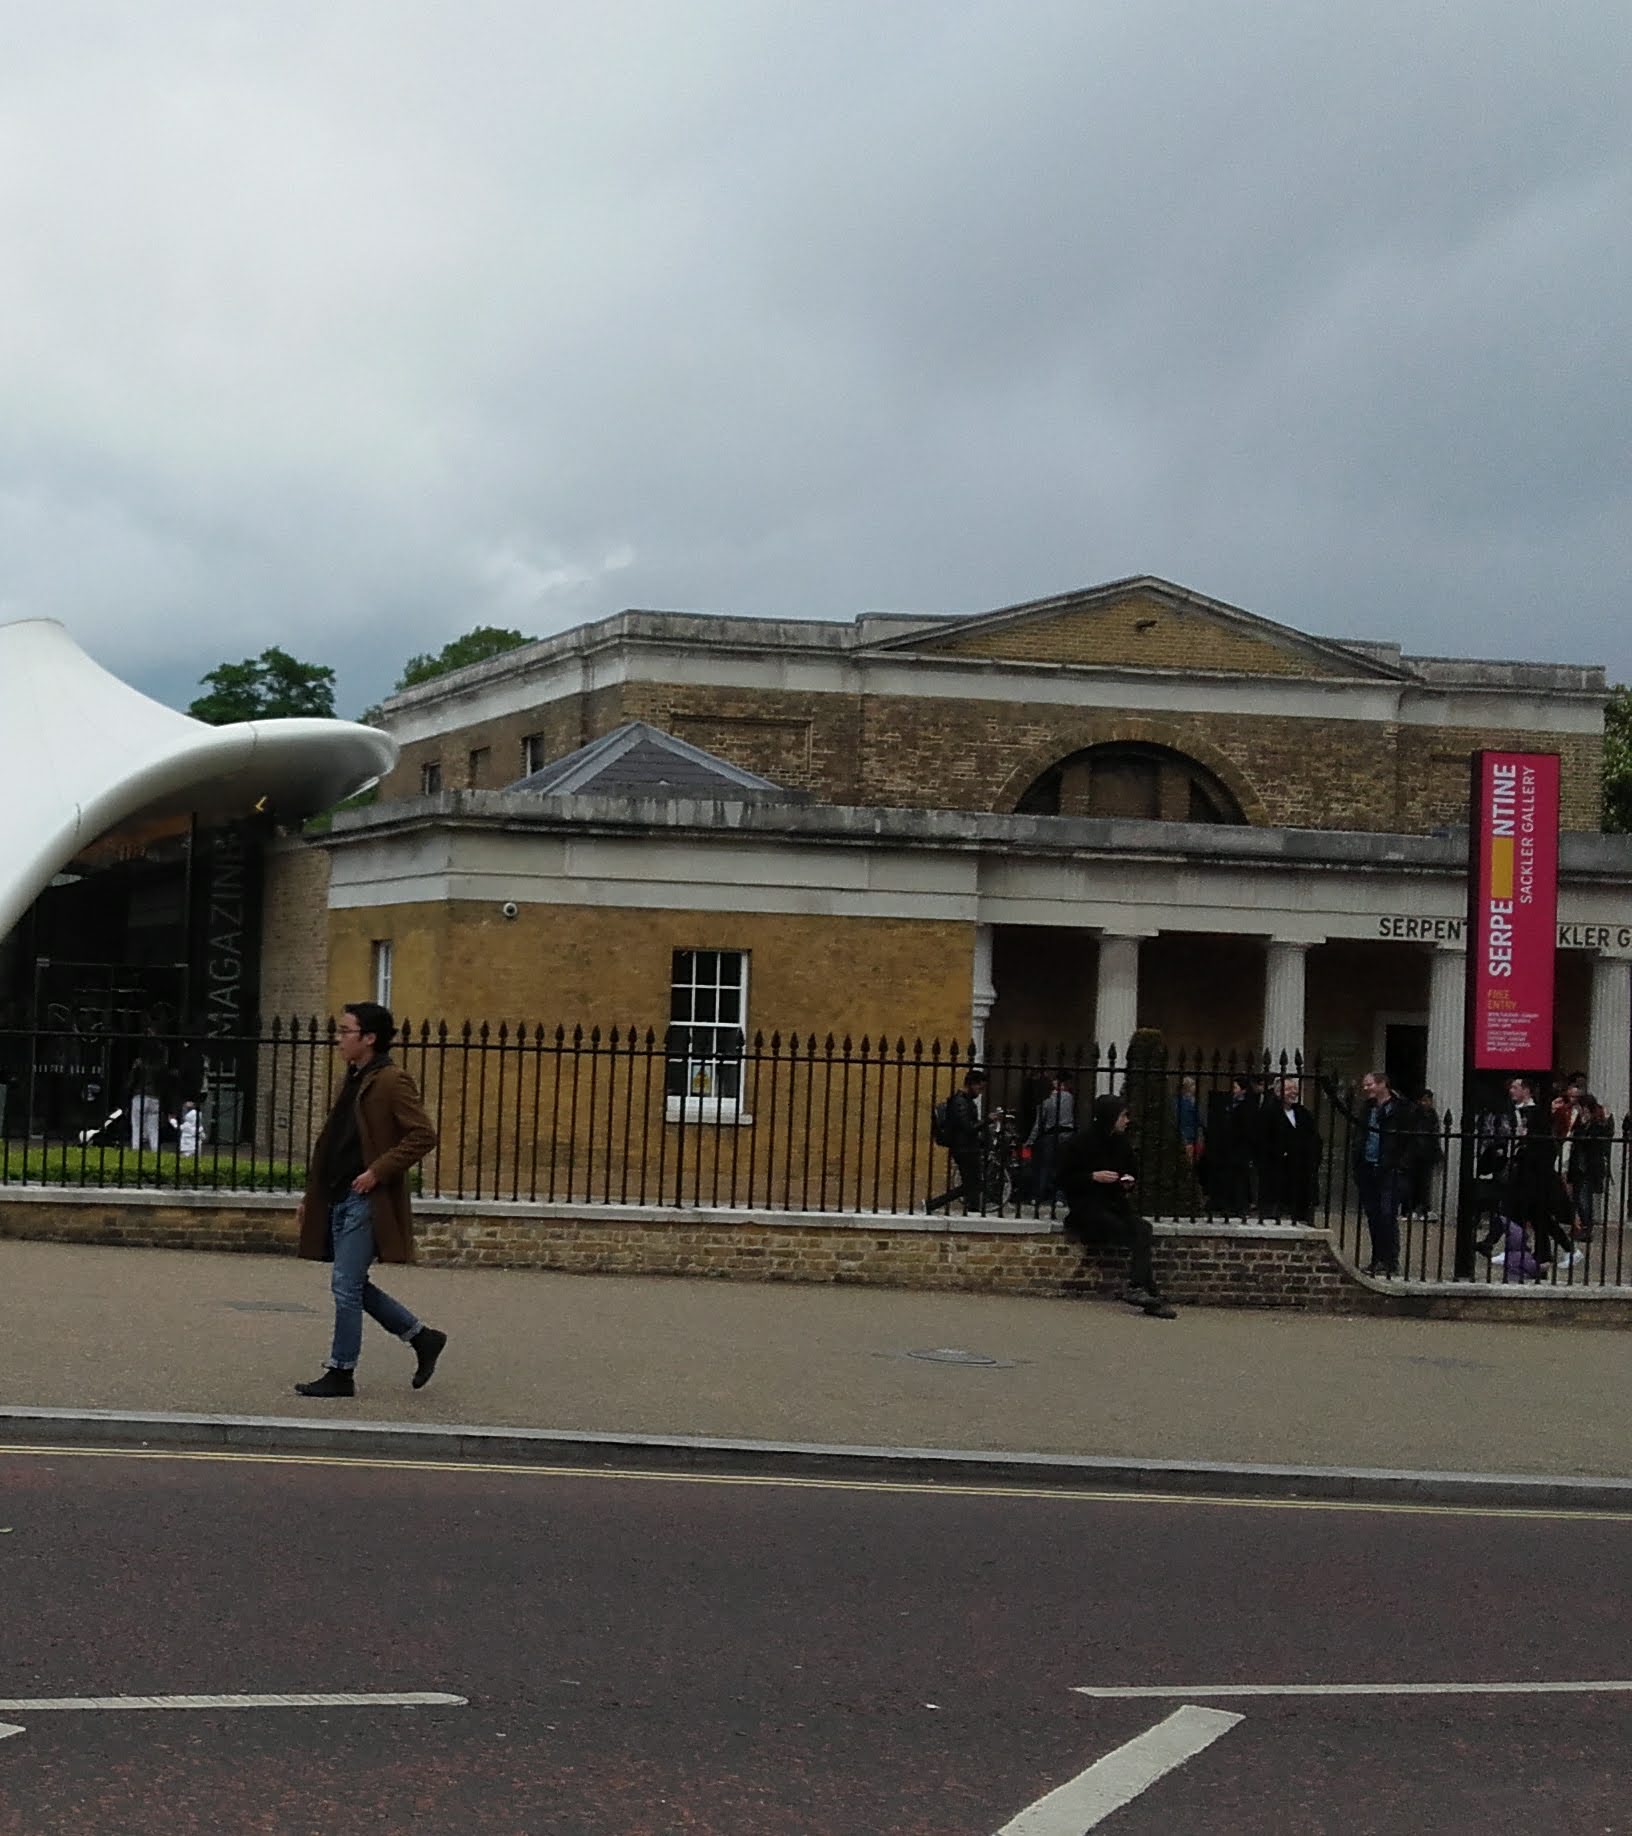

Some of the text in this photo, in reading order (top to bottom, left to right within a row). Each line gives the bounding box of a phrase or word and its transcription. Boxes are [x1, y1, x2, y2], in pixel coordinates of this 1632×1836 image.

[1489, 764, 1516, 976] SERPE NTINE
[1520, 766, 1536, 904] SACKLER GALLERY
[206, 836, 245, 1039] MAGAZINE
